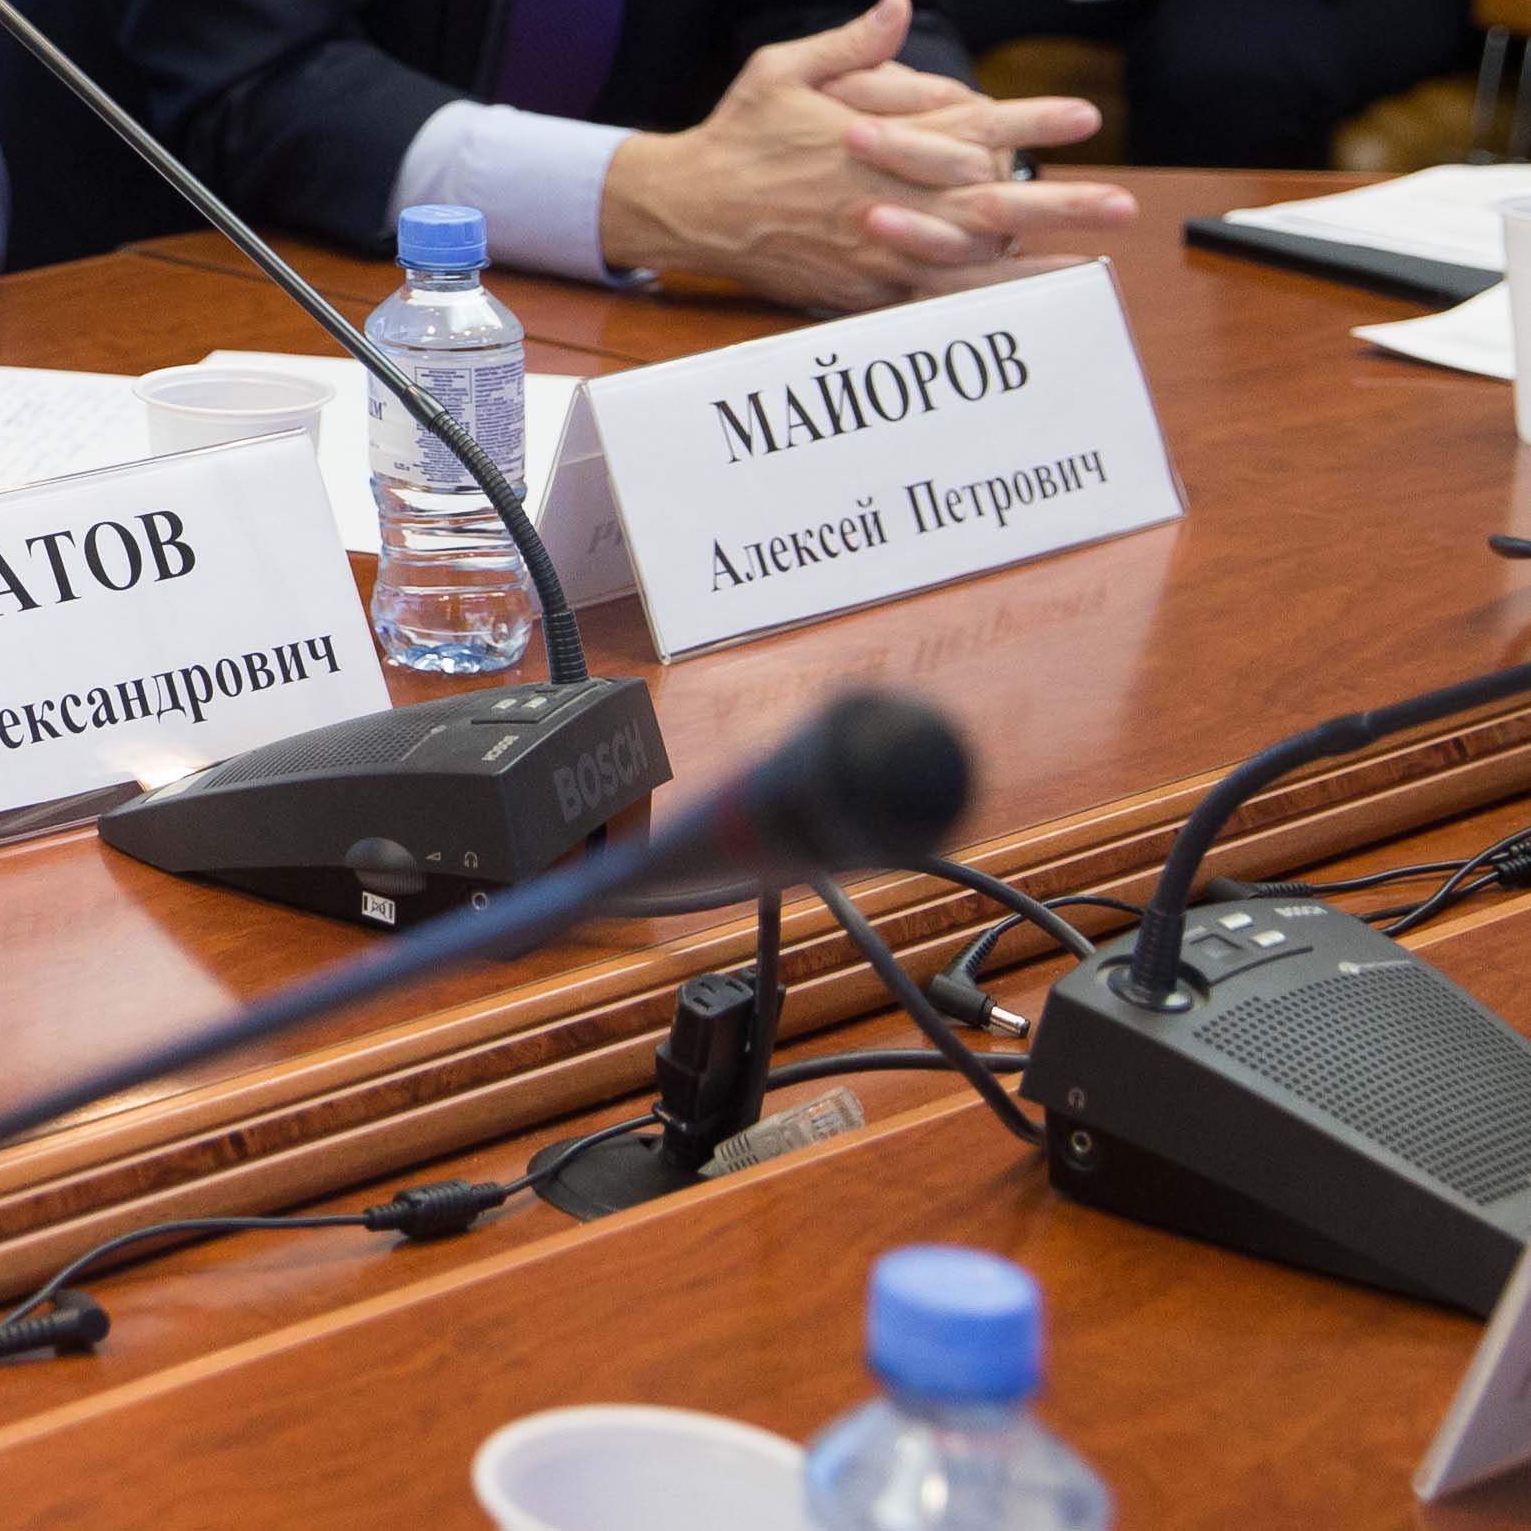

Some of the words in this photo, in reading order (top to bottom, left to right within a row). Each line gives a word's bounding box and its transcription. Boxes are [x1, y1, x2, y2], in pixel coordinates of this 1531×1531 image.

[712, 330, 1029, 465] МАЙОРОВ
[710, 495, 888, 592] Алексей
[904, 448, 1109, 536] Петрович
[554, 718, 648, 822] BOSCH
